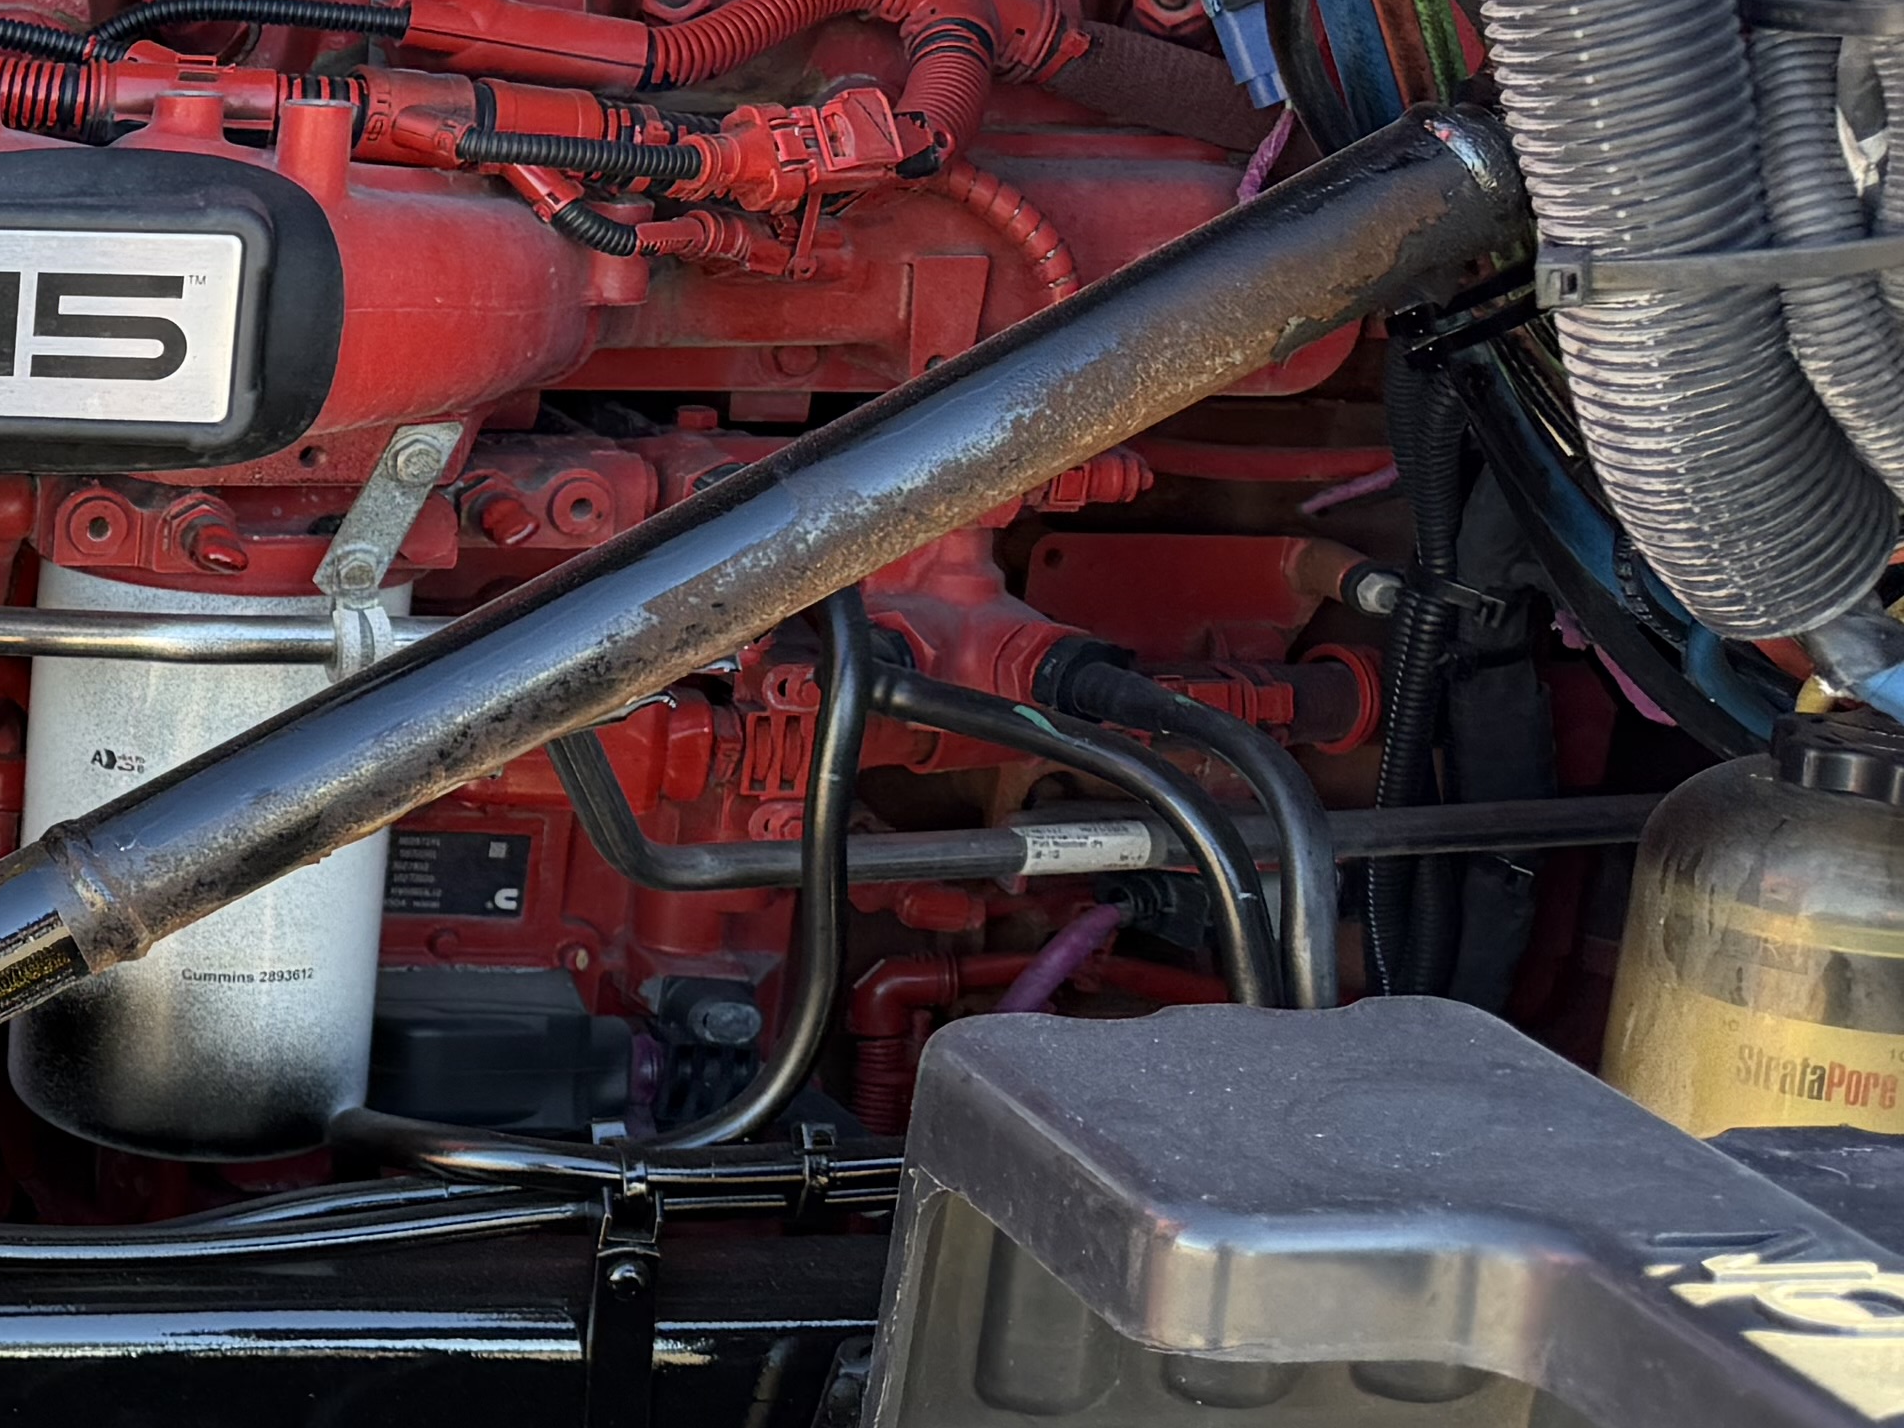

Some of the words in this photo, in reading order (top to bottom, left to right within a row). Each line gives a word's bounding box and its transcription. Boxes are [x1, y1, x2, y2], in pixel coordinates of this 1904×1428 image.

[181, 968, 254, 984] Cummins
[259, 967, 314, 983] 2893612
[1736, 1043, 1899, 1111] StrataPore
